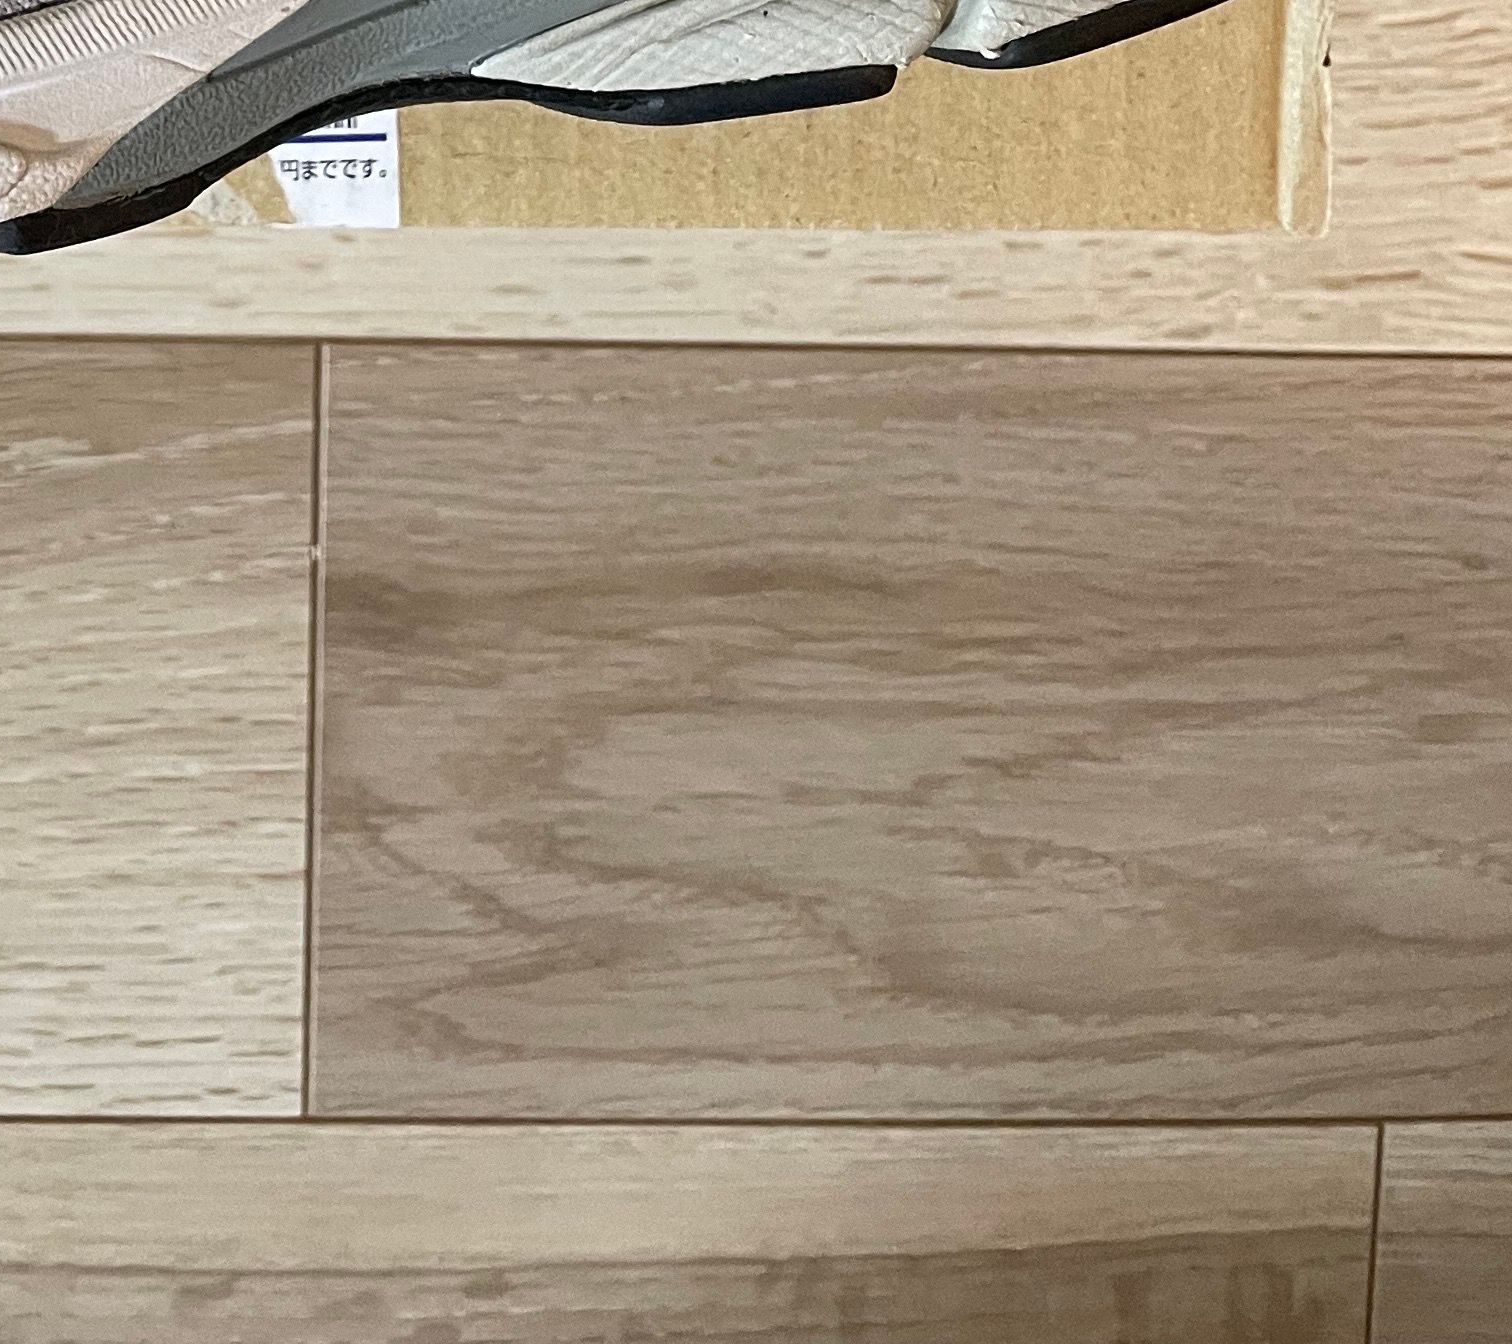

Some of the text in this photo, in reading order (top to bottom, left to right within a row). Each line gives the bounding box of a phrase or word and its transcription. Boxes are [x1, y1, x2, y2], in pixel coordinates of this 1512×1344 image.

[279, 158, 388, 181] 円までです。
